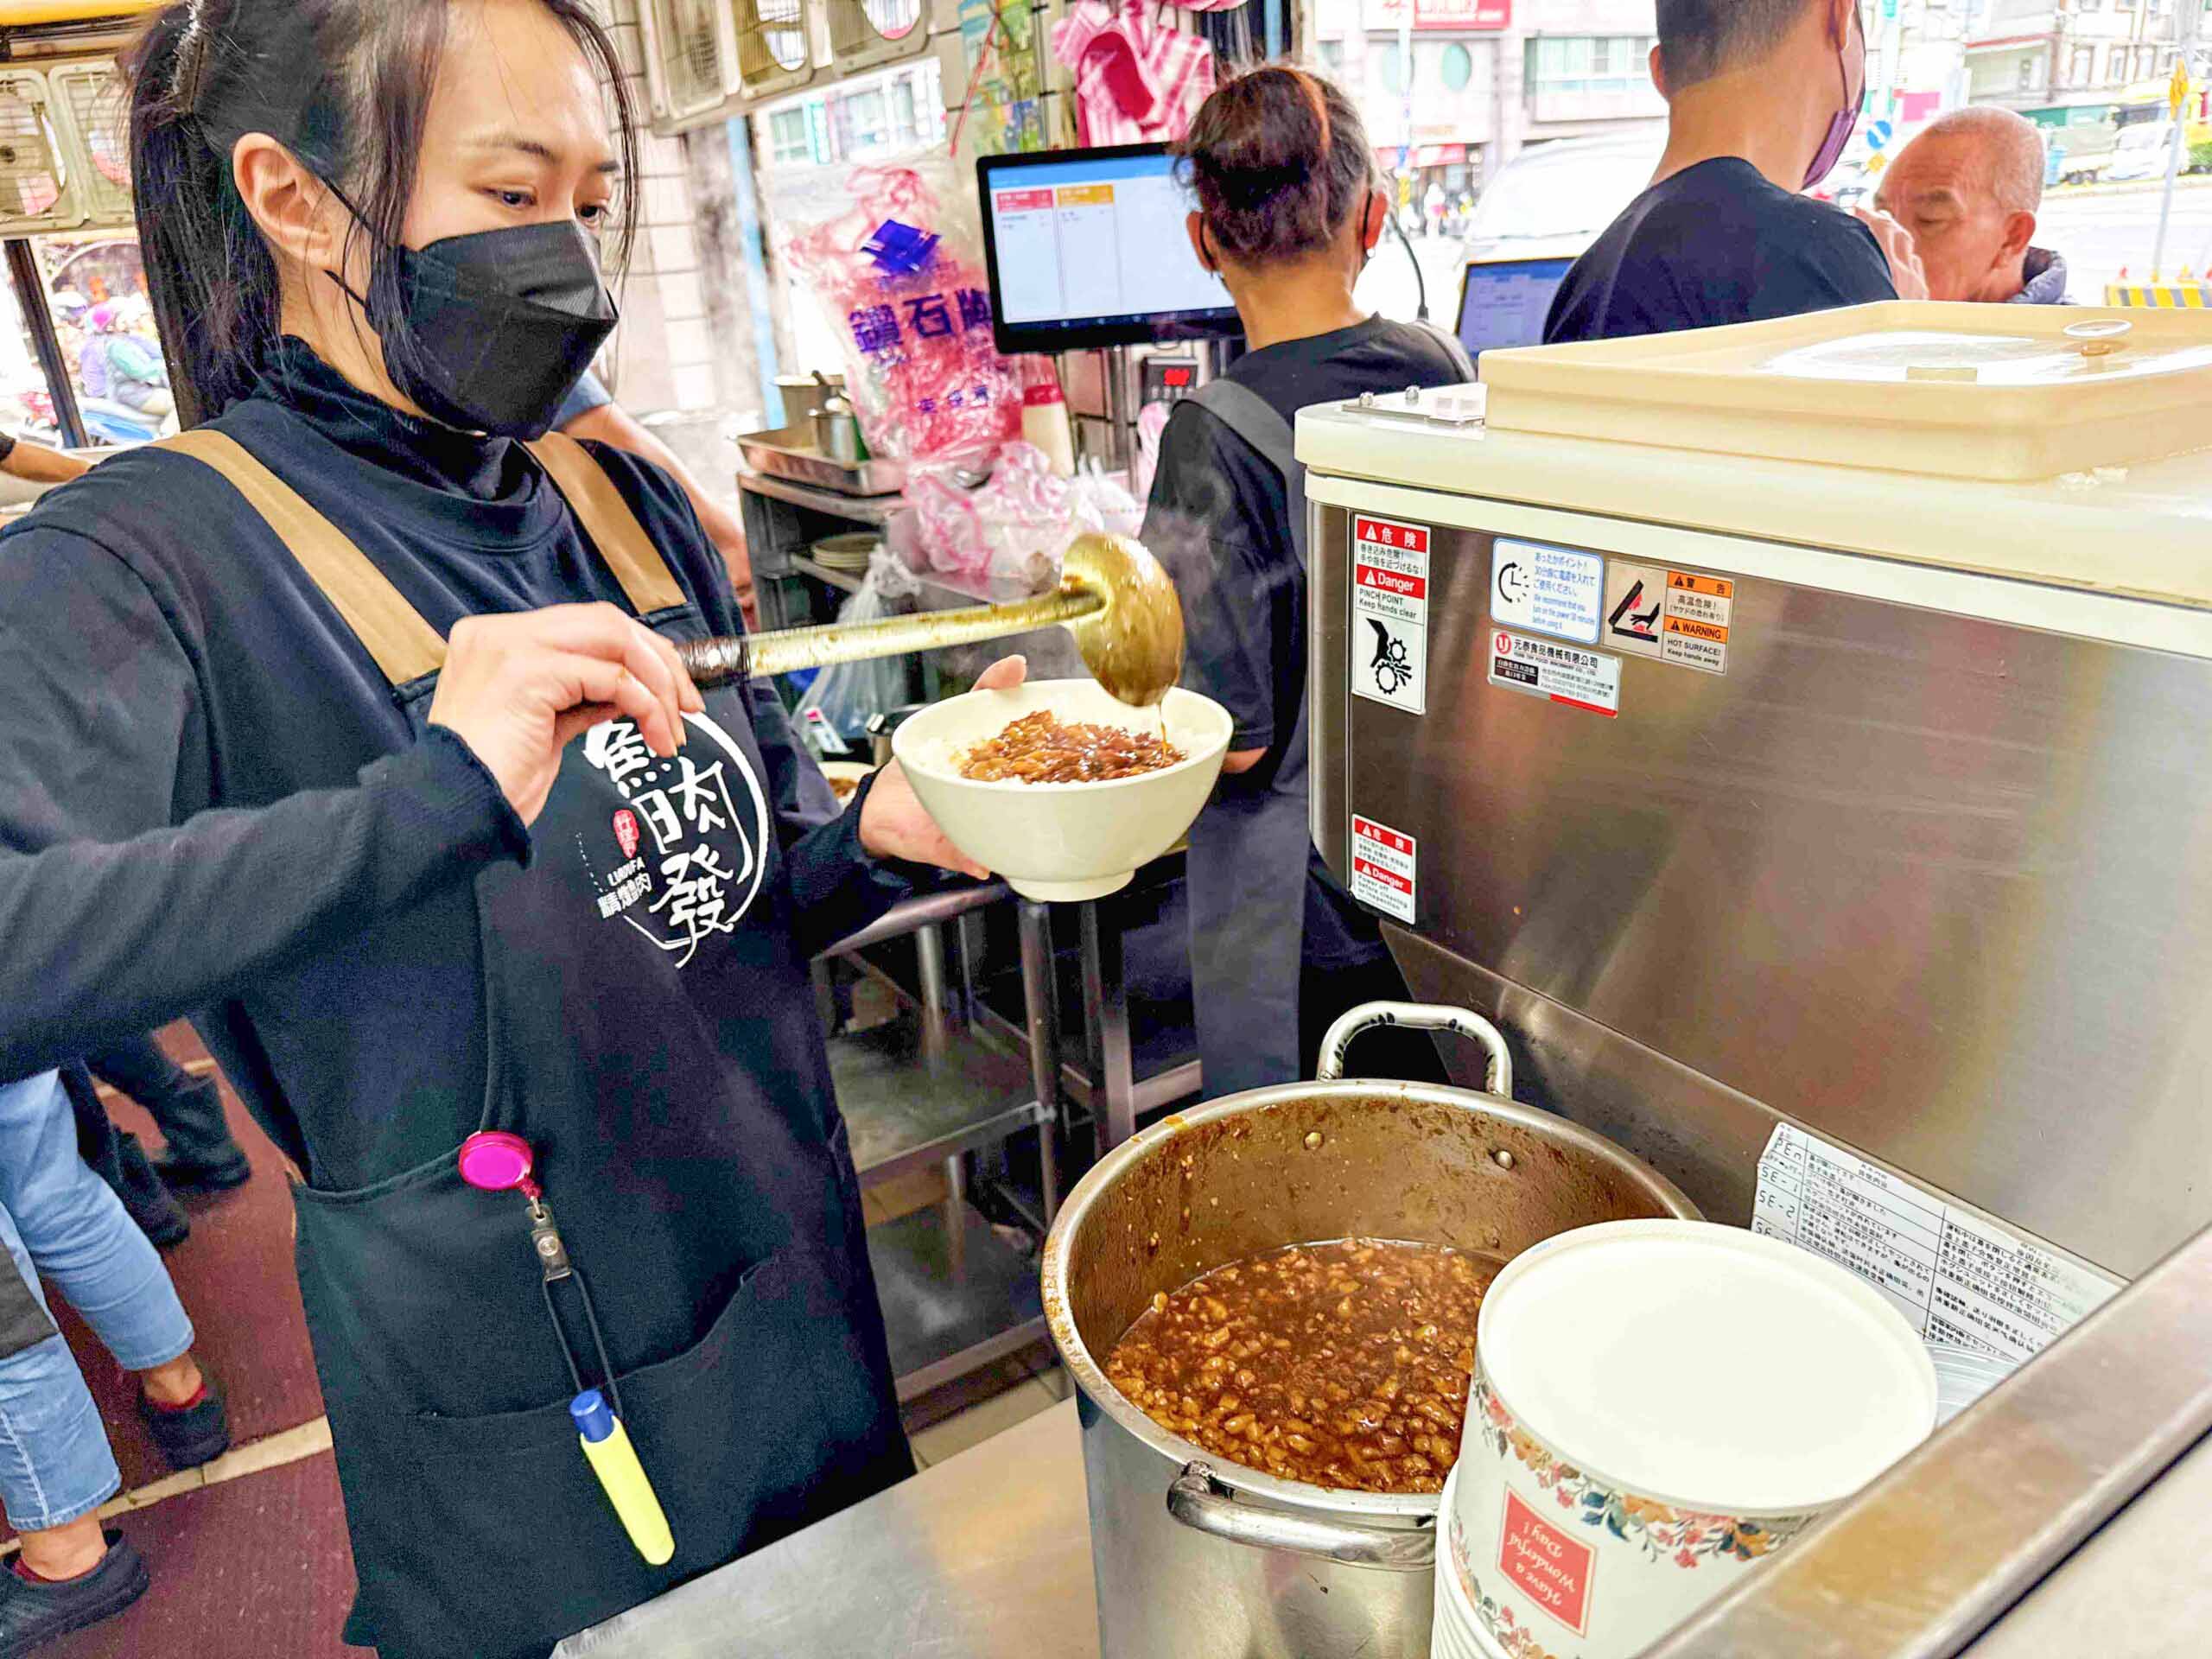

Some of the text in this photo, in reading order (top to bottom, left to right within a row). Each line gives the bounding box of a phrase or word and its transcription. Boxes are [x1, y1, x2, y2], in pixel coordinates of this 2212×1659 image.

[1378, 572, 1414, 592] Danger
[1359, 588, 1403, 605] PINCH POINT
[1359, 598, 1417, 619] Keep hands clear
[1682, 622, 1721, 639] WARNING
[1668, 639, 1721, 657] HOT SURFACE!
[1668, 648, 1719, 666] Keep hands away
[1372, 868, 1404, 889] Danger
[1507, 1532, 1576, 1593] Wonderful
[1516, 1561, 1562, 1605] Have a
